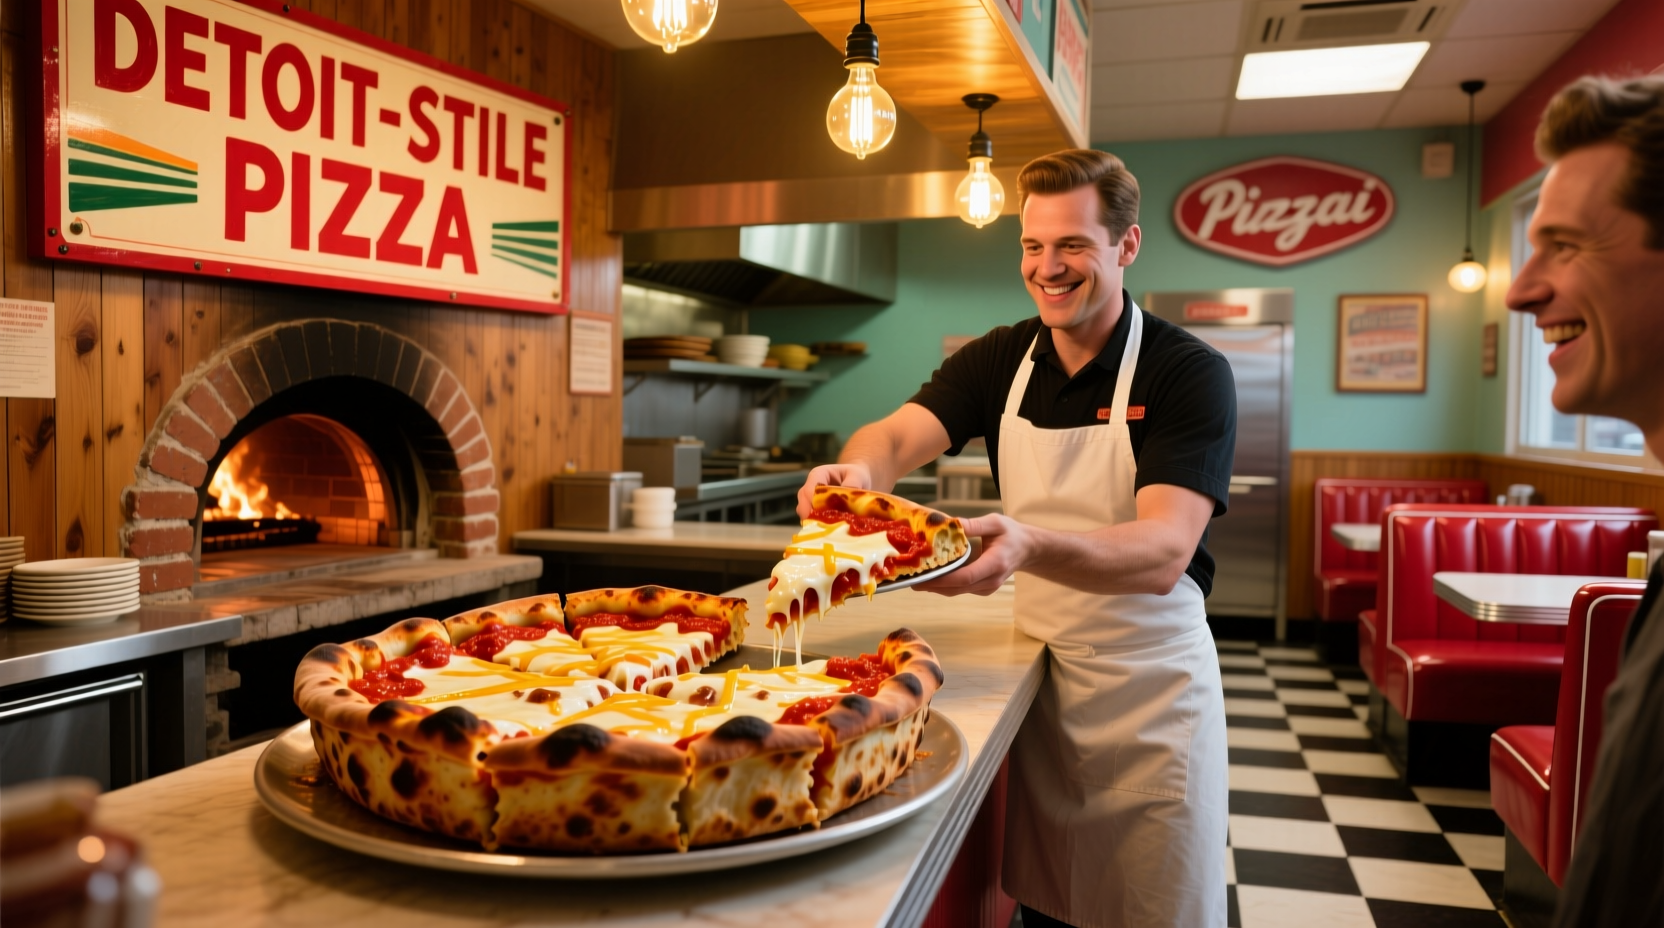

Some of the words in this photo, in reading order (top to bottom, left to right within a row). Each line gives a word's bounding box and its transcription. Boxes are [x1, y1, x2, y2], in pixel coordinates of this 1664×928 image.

[94, 0, 547, 191] DETOIT-STILE
[225, 137, 478, 275] PIZZA
[1198, 177, 1377, 252] Pizzai
